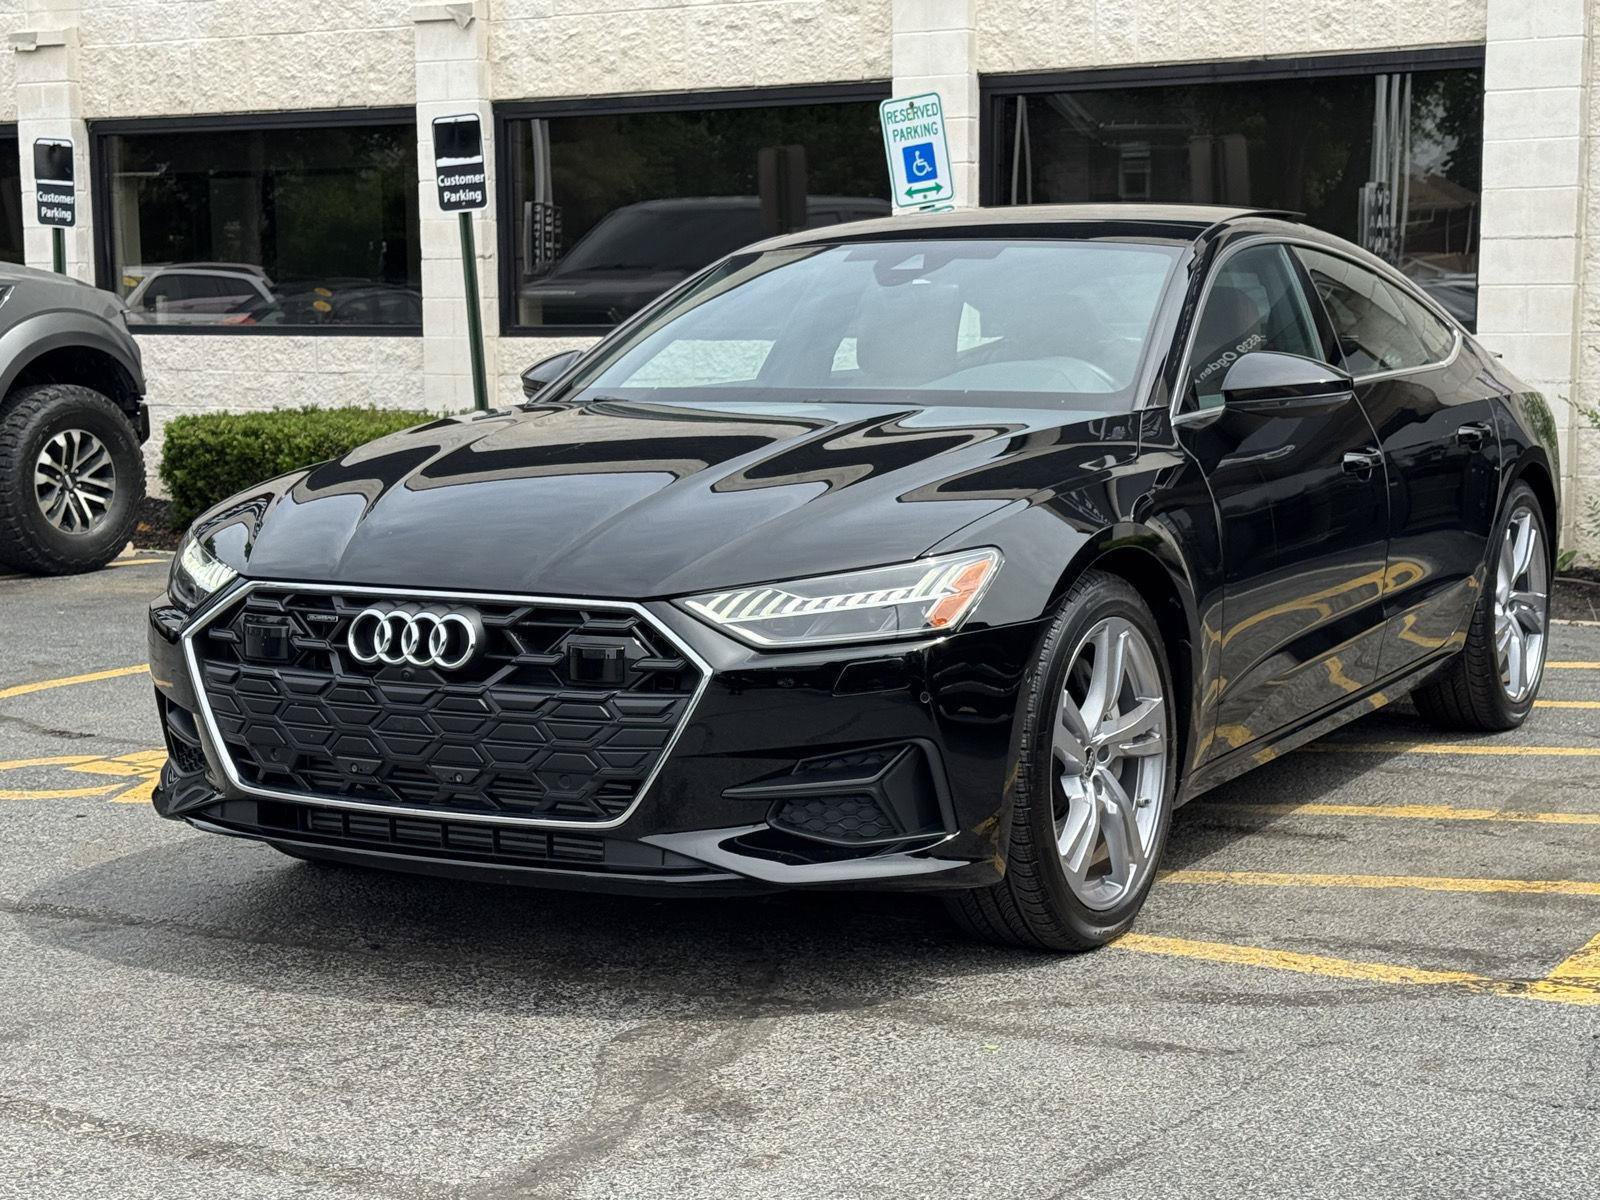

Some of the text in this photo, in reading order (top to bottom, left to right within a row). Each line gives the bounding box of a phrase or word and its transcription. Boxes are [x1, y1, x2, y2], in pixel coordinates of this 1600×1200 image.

[886, 103, 939, 125] RESERVED
[892, 122, 939, 143] PARKING
[438, 173, 485, 187] Customer
[37, 191, 75, 205] Customer
[443, 189, 482, 203] Parking
[41, 207, 72, 222] Parking
